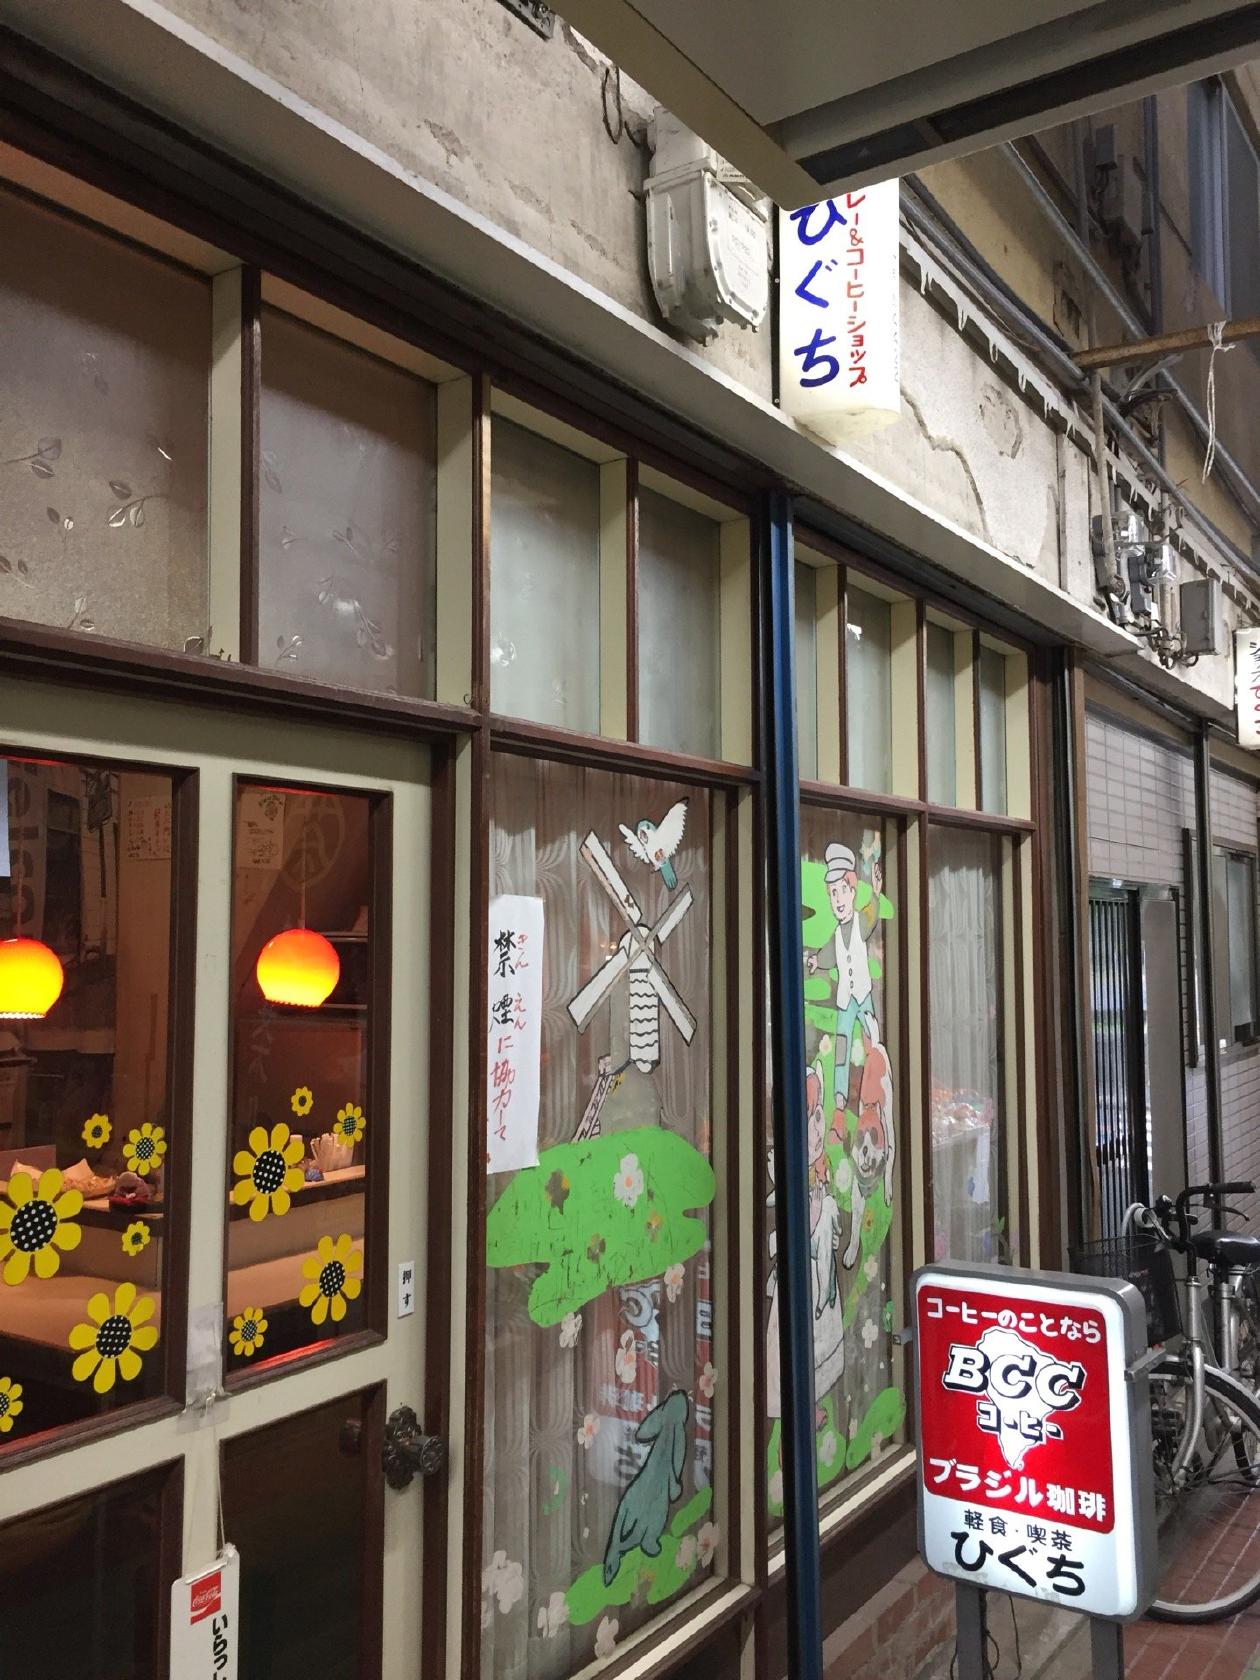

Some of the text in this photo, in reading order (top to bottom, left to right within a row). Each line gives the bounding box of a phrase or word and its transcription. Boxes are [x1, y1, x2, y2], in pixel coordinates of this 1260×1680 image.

[789, 199, 848, 388] ひぐち
[927, 1297, 1102, 1345] コーヒーのことなら
[944, 1345, 1088, 1411] BCC
[977, 1401, 1064, 1444] コーヒー
[929, 1457, 1107, 1523] ブラジル珈琲
[951, 1530, 1086, 1597] ひぐち
[212, 1613, 228, 1680] いらっ
